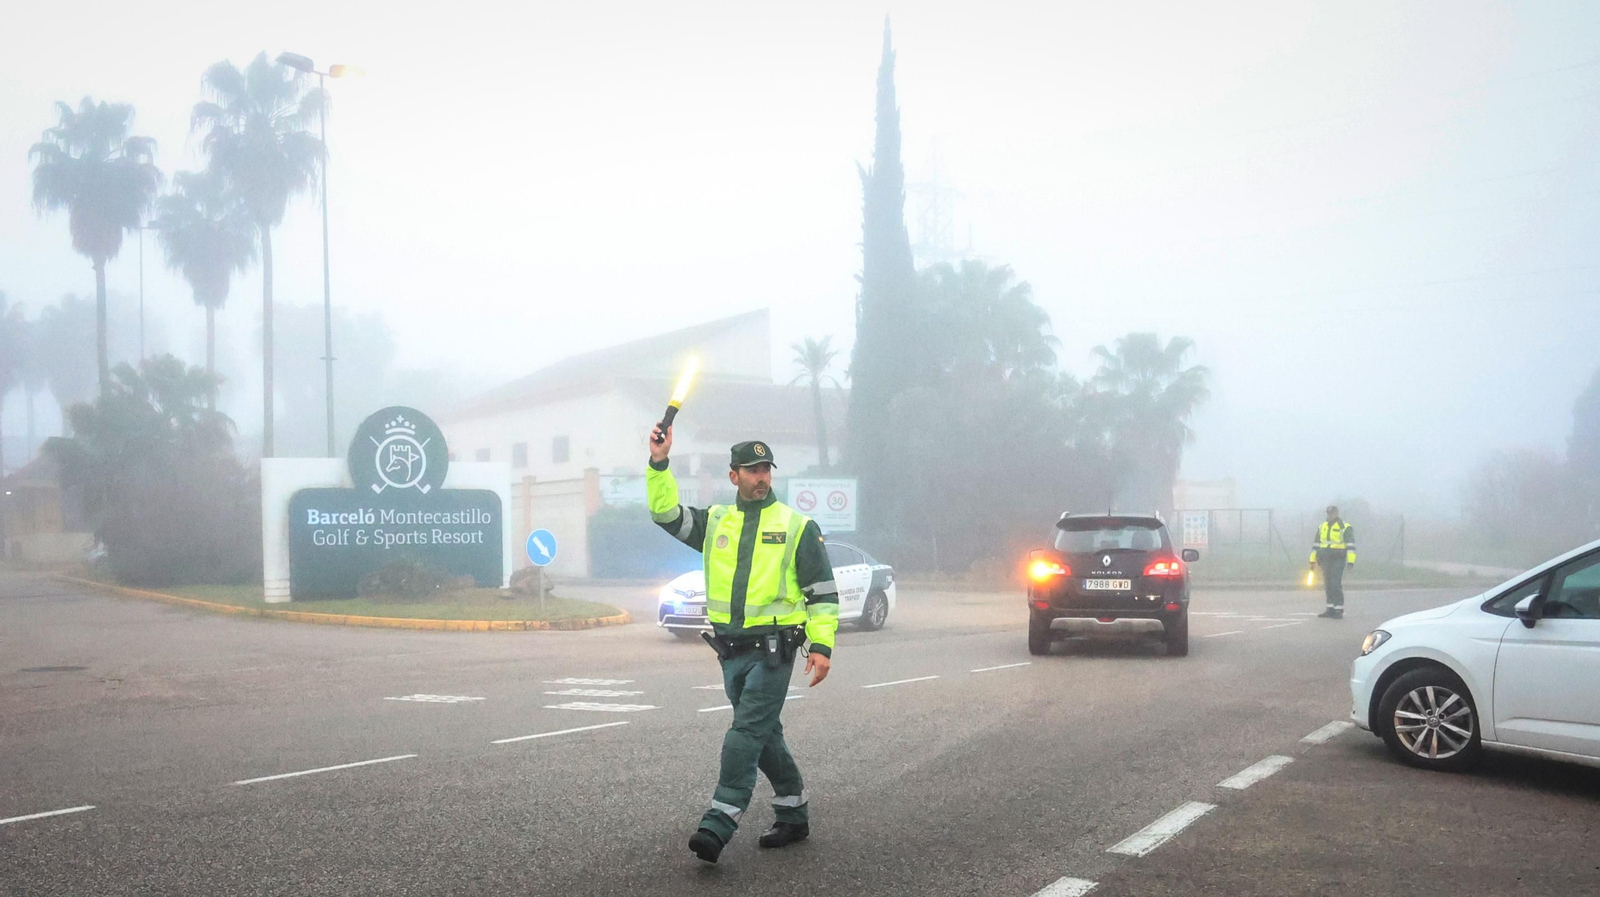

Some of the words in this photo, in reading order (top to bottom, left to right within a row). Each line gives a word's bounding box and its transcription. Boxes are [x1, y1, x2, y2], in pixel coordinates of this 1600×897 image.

[831, 497, 843, 505] 30
[307, 508, 375, 525] Barceló
[379, 508, 491, 525] Montecastillo
[312, 529, 350, 546] Golf
[355, 529, 369, 545] &
[373, 529, 427, 549] Sports
[431, 529, 483, 544] Resort
[1088, 580, 1110, 588] 7988
